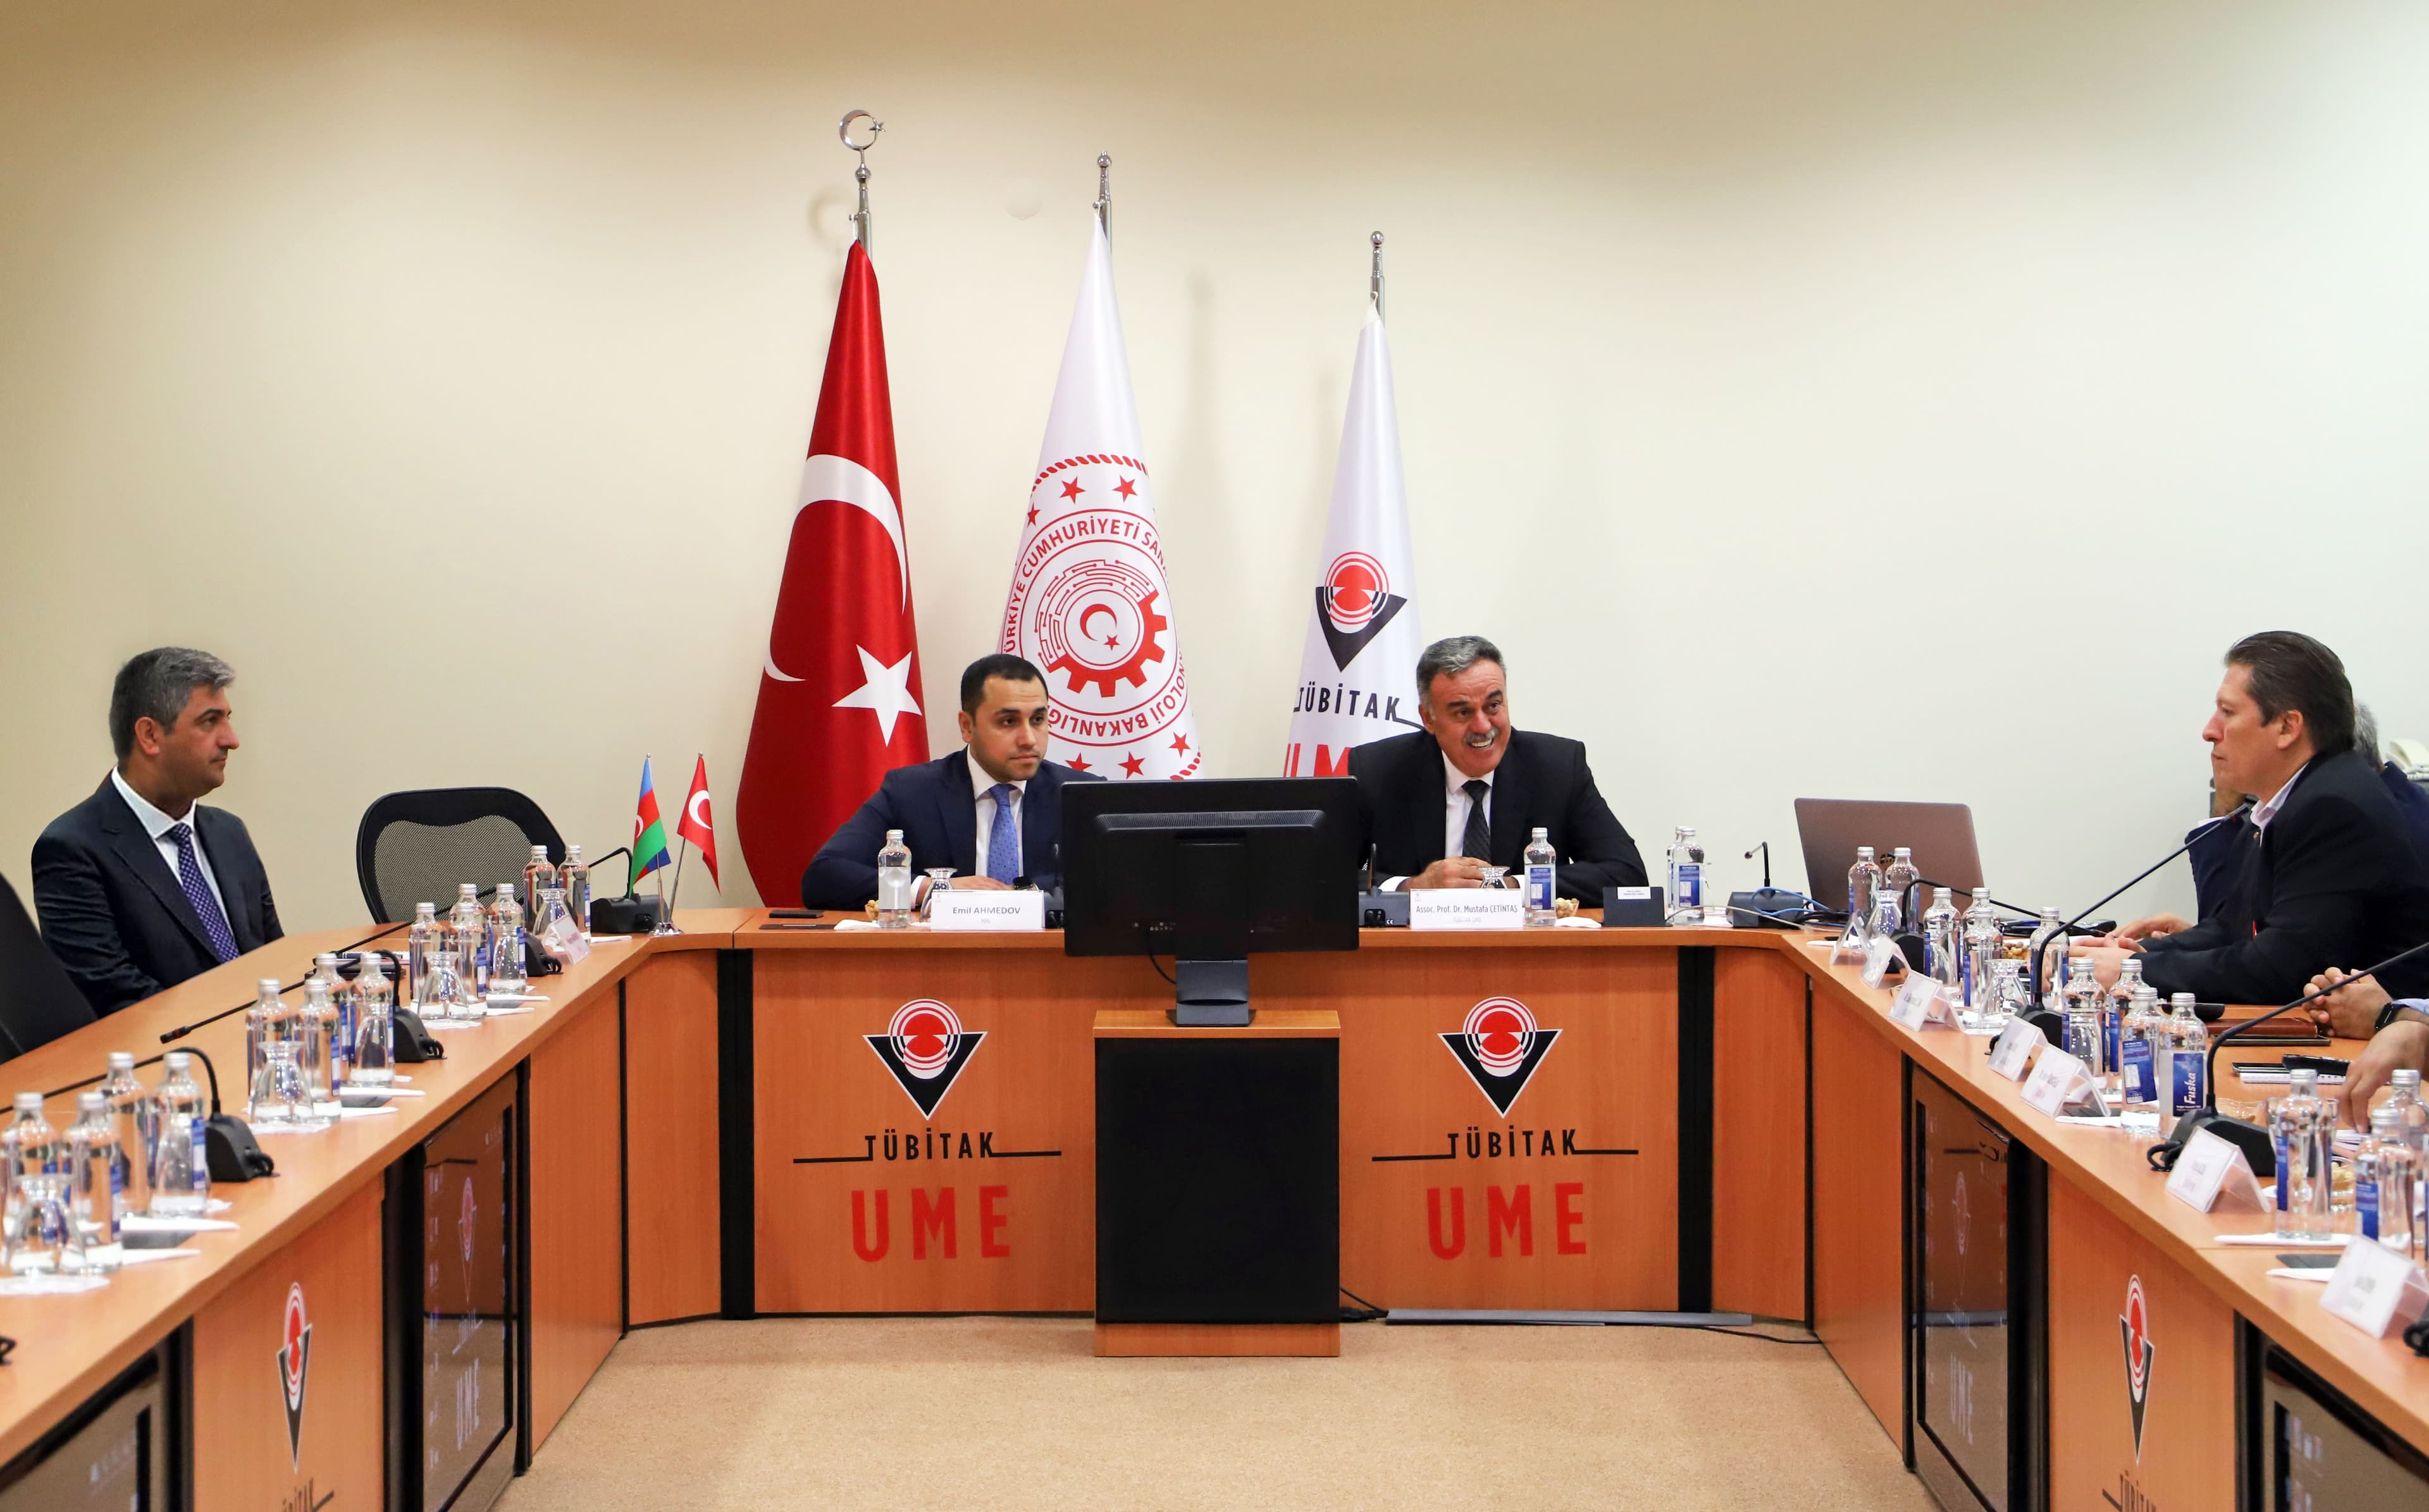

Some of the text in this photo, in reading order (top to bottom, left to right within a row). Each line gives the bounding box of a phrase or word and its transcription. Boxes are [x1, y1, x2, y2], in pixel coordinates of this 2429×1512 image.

[1022, 515, 1141, 578] CUMHURİYETİ
[1141, 531, 1166, 577] SAN
[1047, 661, 1185, 737] NOLOJİ BAKANLIĞ
[1294, 681, 1400, 722] TÜBİTAK
[1464, 905, 1488, 913] Mustafa
[2183, 1072, 2197, 1105] Fuska
[865, 1128, 994, 1162] TÜBİTAK
[1447, 1124, 1576, 1159] TÜBİTAK
[851, 1184, 1010, 1263] UME
[1426, 1182, 1587, 1261] UME
